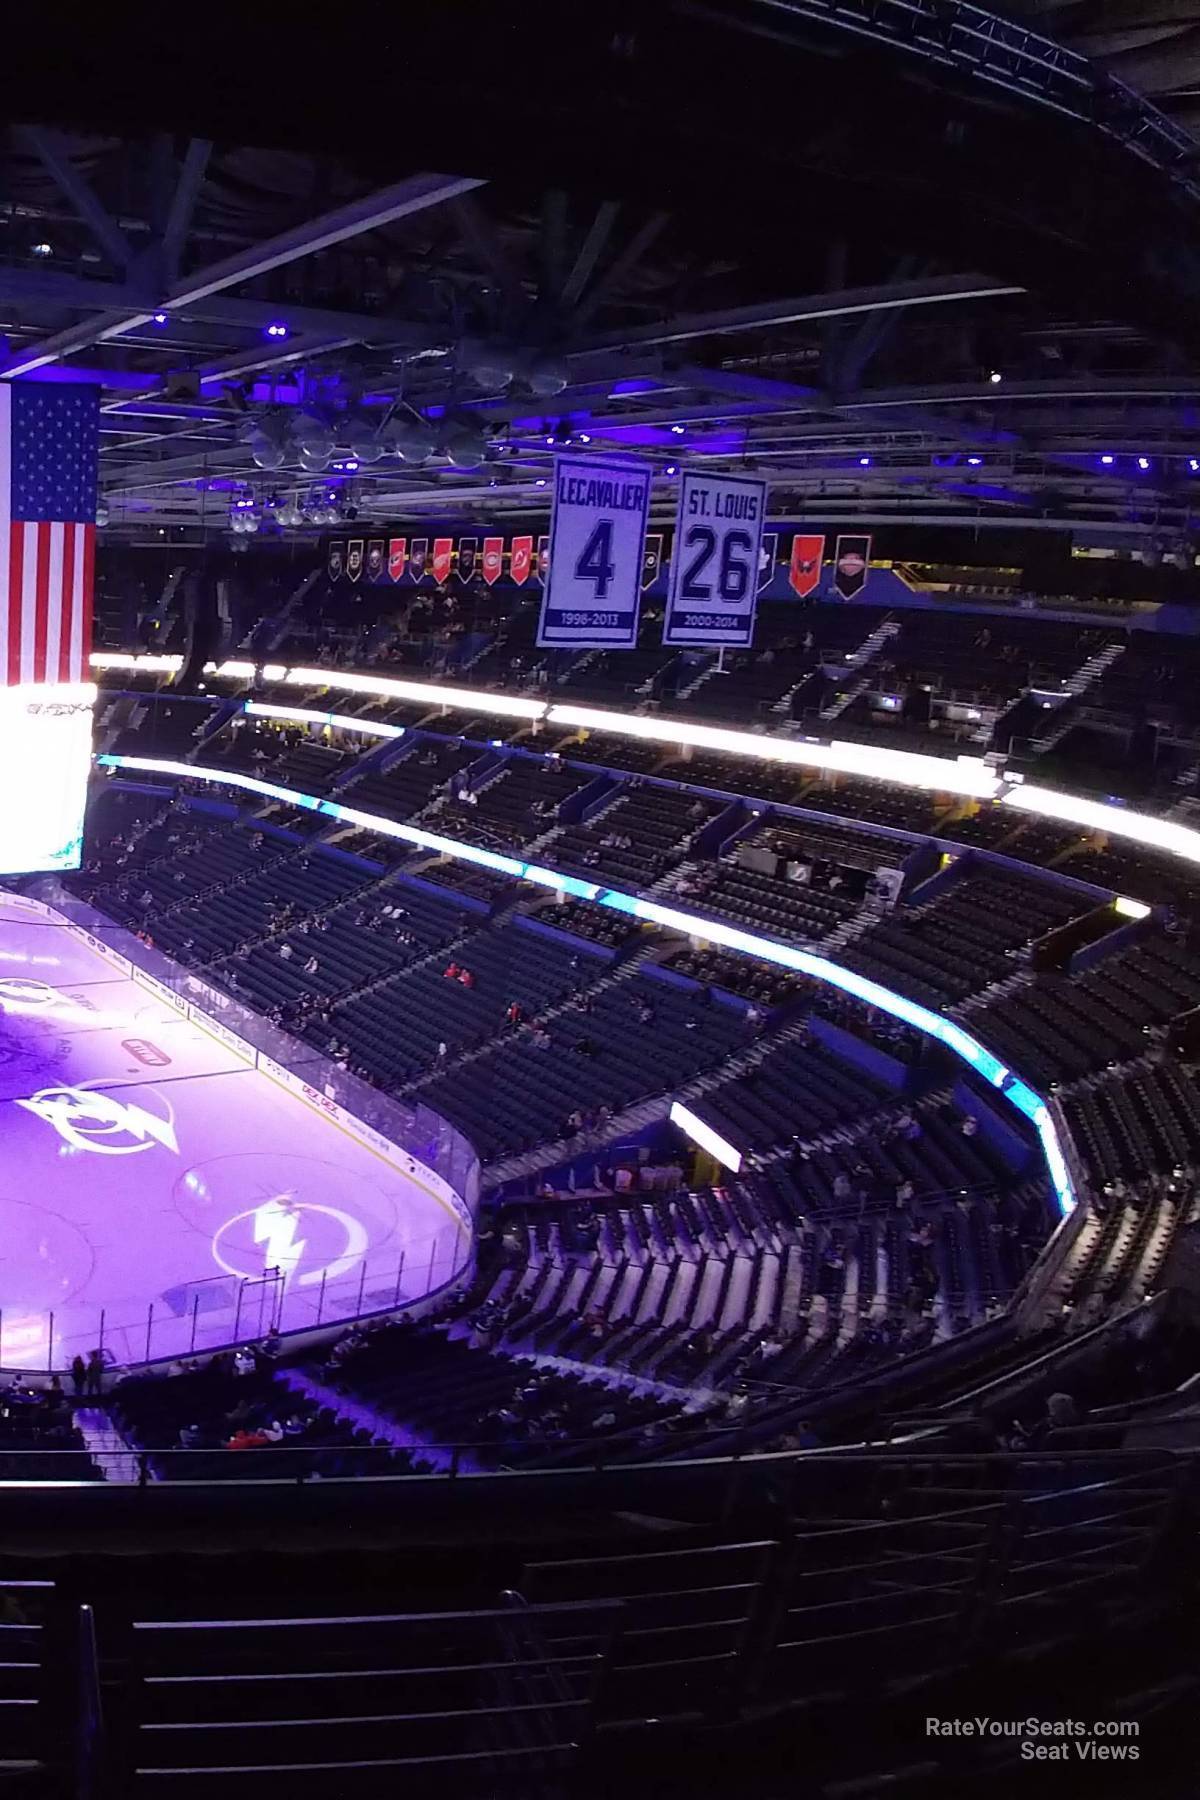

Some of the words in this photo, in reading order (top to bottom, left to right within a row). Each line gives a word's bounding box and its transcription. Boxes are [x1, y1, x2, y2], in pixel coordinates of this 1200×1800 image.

[559, 476, 643, 511] LECAVALIER
[689, 489, 710, 516] ST.
[715, 493, 758, 521] LOUIS
[575, 518, 616, 599] 4
[679, 524, 752, 603] 26
